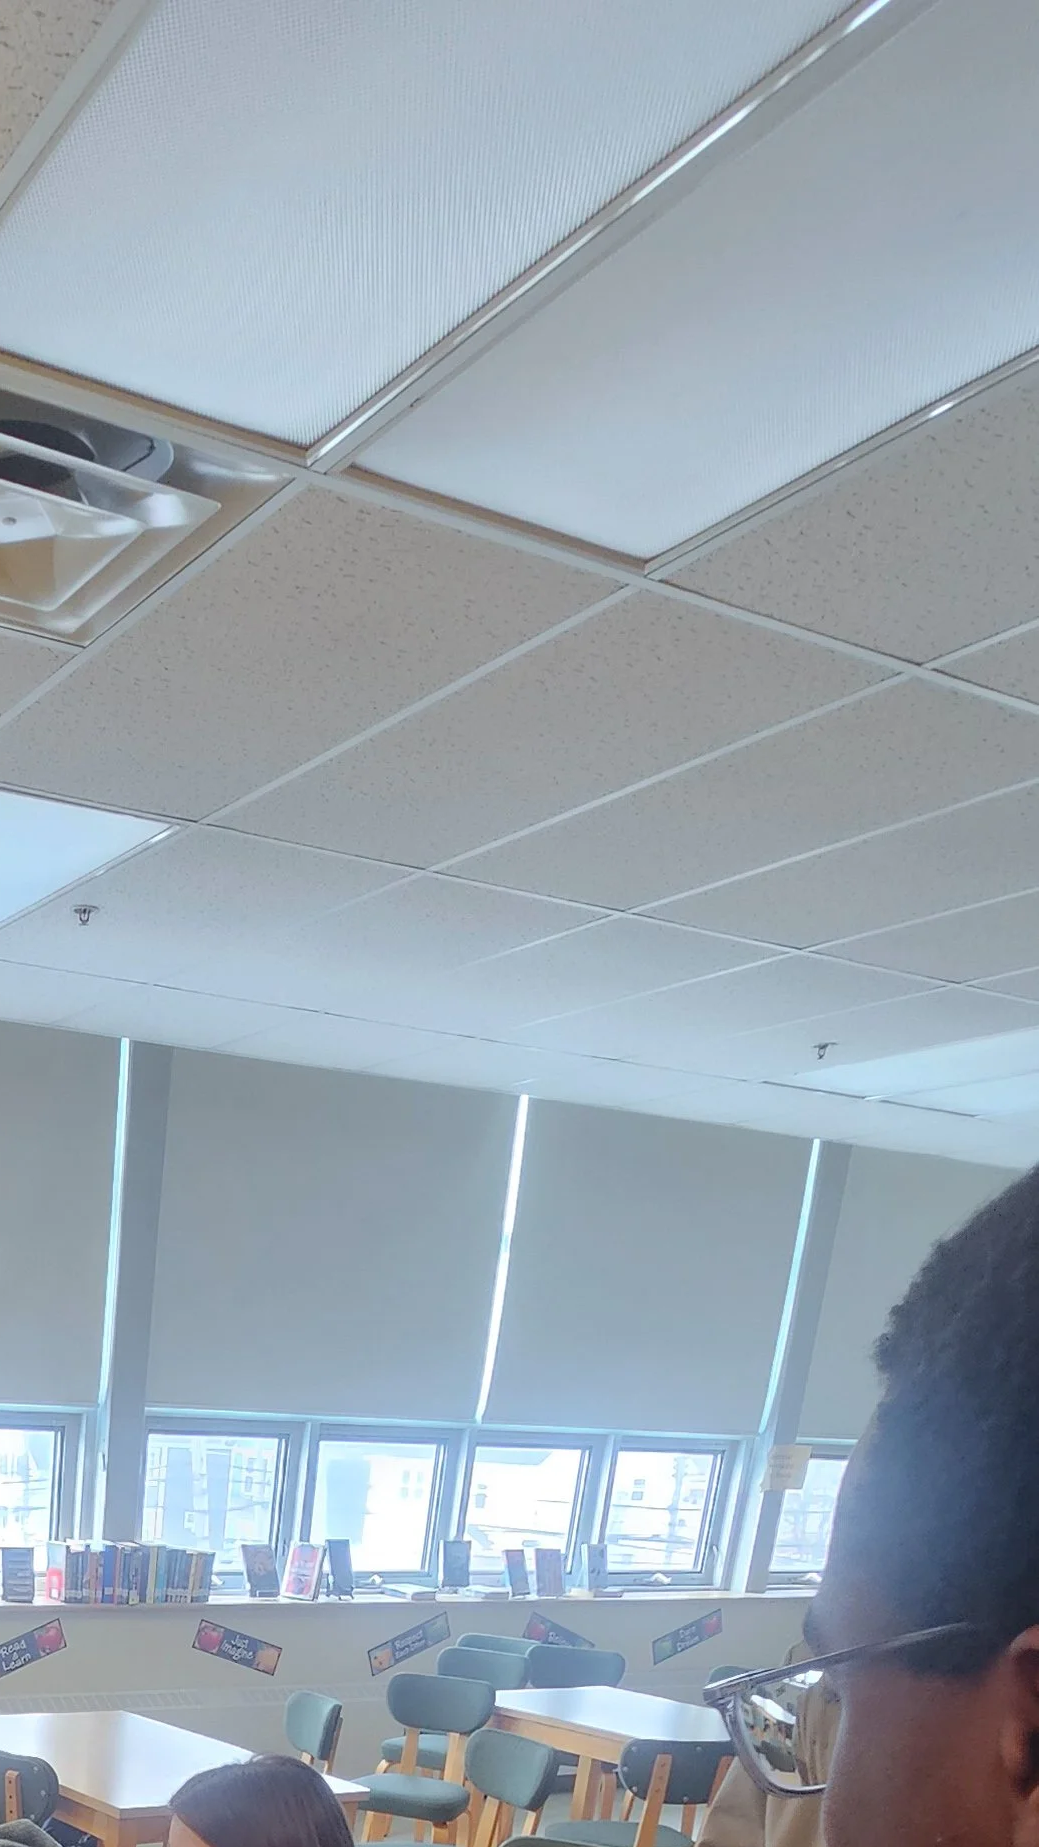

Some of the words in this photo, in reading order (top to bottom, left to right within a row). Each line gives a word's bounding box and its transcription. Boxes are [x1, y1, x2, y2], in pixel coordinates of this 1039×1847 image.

[0, 1640, 27, 1658] Read
[221, 1640, 254, 1661] Imagine
[2, 1653, 31, 1671] Learn
